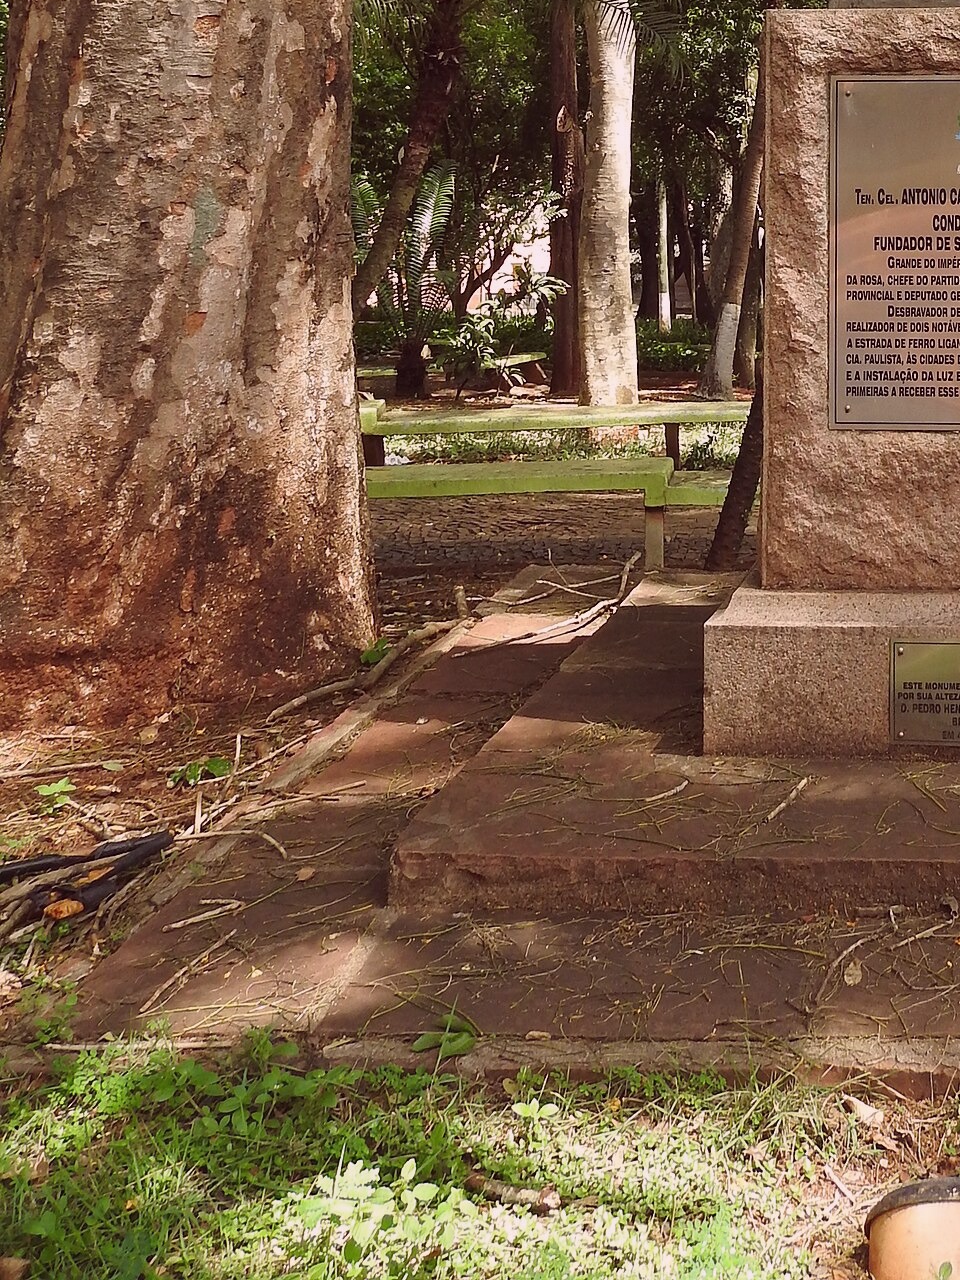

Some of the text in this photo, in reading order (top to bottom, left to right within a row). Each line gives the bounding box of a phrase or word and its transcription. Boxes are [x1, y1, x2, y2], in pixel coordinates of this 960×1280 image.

[902, 188, 946, 204] ANTONIO
[874, 236, 932, 251] FUNDADOR
[938, 236, 950, 251] DE
[888, 256, 922, 269] GRANDE
[924, 258, 936, 268] DO
[846, 275, 858, 285] DA
[860, 275, 884, 287] ROSA,
[888, 275, 914, 285] CHEFE
[916, 275, 928, 285] DO
[846, 291, 894, 301] PROVINCIAL
[897, 291, 902, 301] E
[905, 291, 948, 301] DEPUTADO
[888, 306, 948, 317] DESBRAVADOR
[951, 307, 960, 317] DE
[846, 322, 894, 332] REALIZADOR
[897, 322, 908, 332] DE
[910, 322, 929, 332] DOIS
[847, 339, 852, 348] A
[856, 339, 892, 348] ESTRADA
[895, 339, 906, 348] DE
[909, 339, 935, 348] FERRO
[846, 354, 861, 364] CIA.
[864, 354, 904, 366] PAULISTA,
[906, 352, 917, 364] ÀS
[920, 354, 954, 364] CIDADES
[846, 371, 852, 381] E
[854, 371, 860, 381] A
[863, 368, 918, 384] INSTALAÇÃO
[922, 371, 933, 381] DA
[936, 371, 953, 381] LUZ
[846, 387, 888, 397] PRIMEIRAS
[891, 387, 896, 397] A
[899, 387, 935, 397] RECEBER
[938, 387, 959, 397] ESSE
[901, 704, 909, 714] D.
[912, 704, 941, 714] PEDRO
[943, 731, 954, 739] EM
